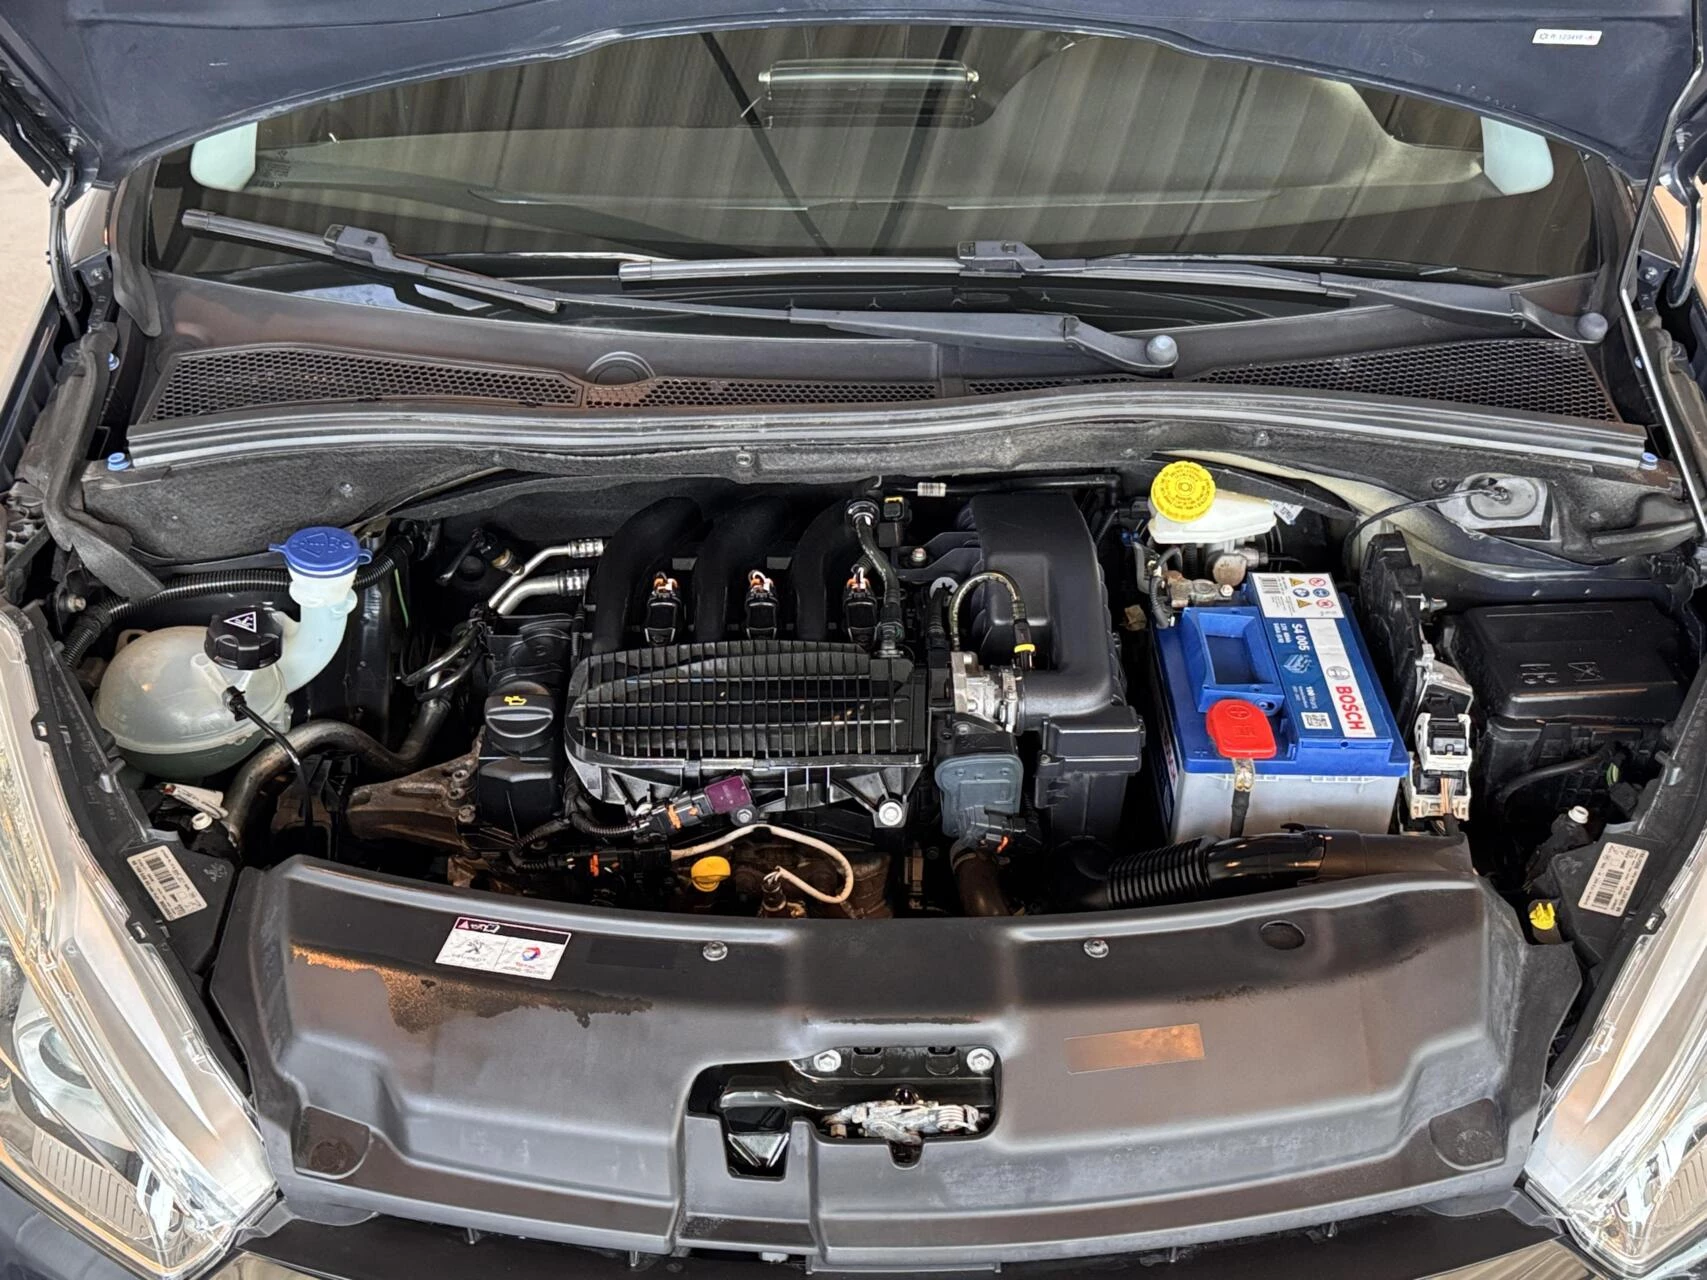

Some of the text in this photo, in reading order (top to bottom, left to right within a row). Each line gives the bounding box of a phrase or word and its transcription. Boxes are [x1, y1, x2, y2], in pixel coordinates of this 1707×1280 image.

[1291, 623, 1310, 651] S4 005
[1335, 685, 1367, 730] BOSCH
